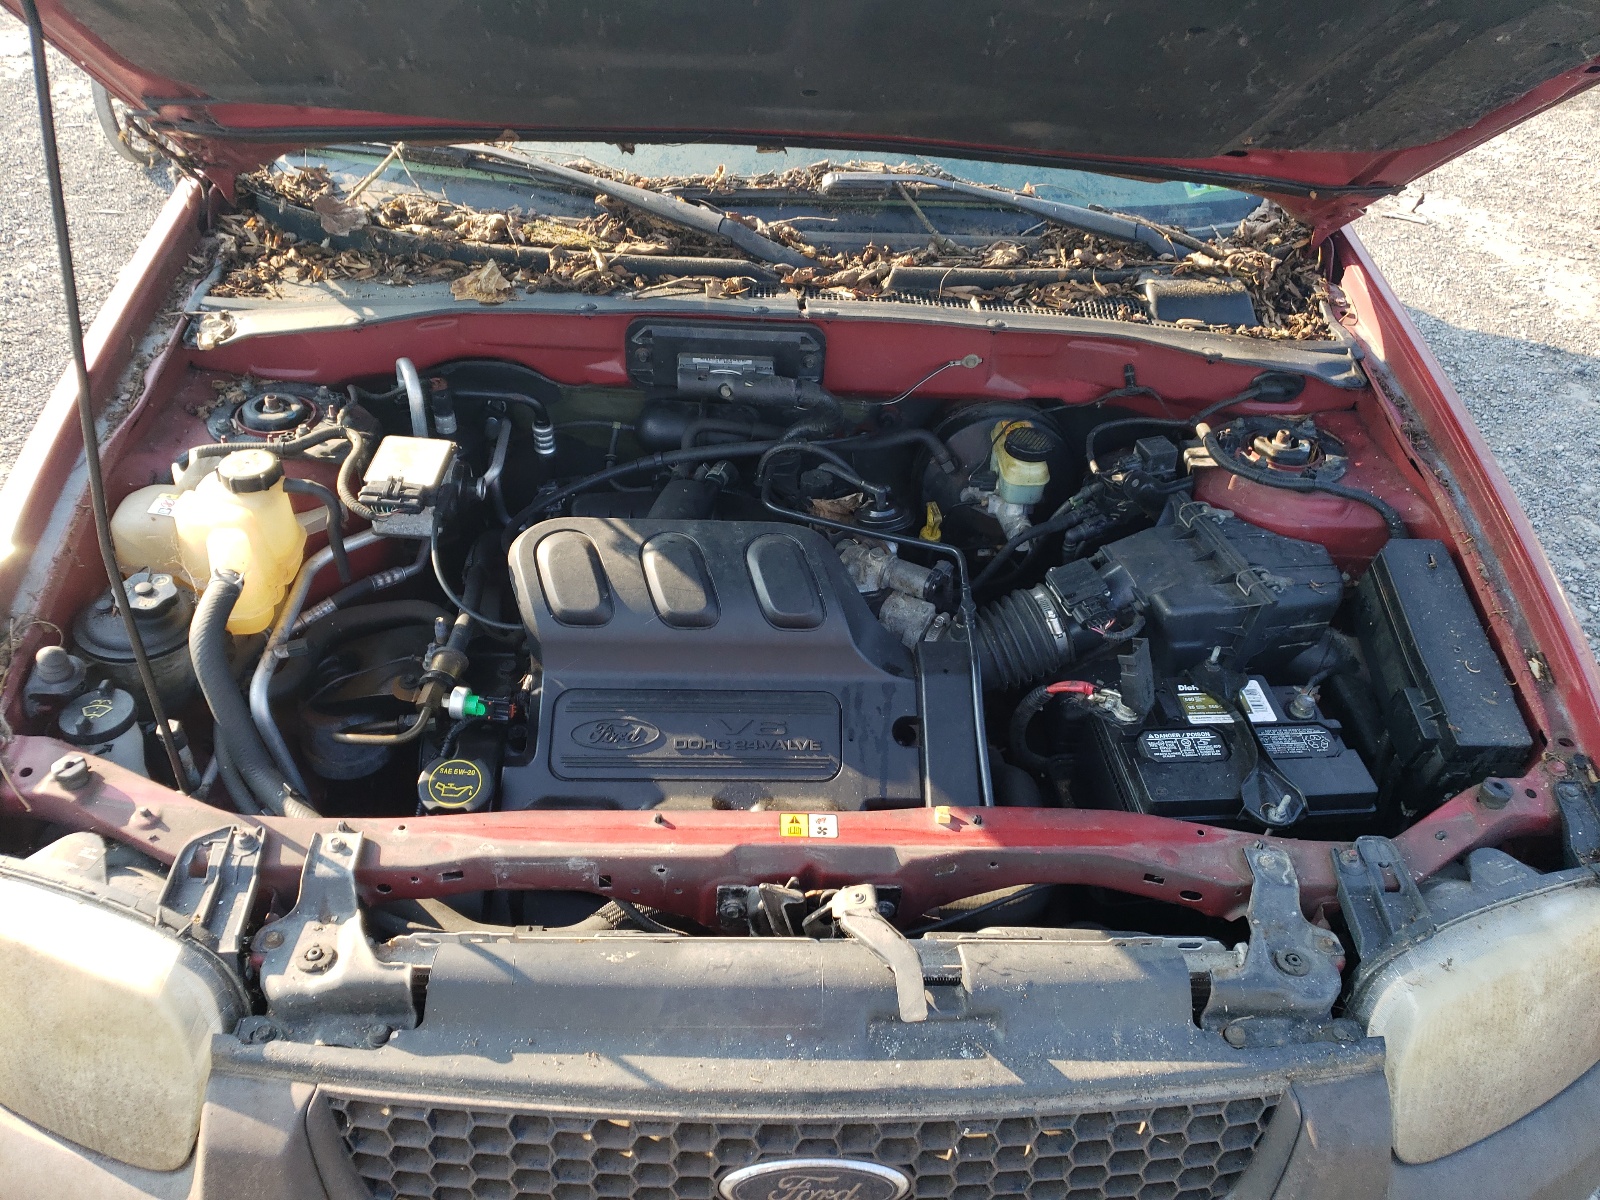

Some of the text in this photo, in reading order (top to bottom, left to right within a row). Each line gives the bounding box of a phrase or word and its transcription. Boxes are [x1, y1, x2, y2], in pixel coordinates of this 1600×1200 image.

[590, 722, 640, 744] Ford
[712, 717, 788, 735] V6
[673, 738, 731, 751] DOHC
[440, 767, 476, 776] SAE 5W-20
[767, 1175, 863, 1200] Ford
